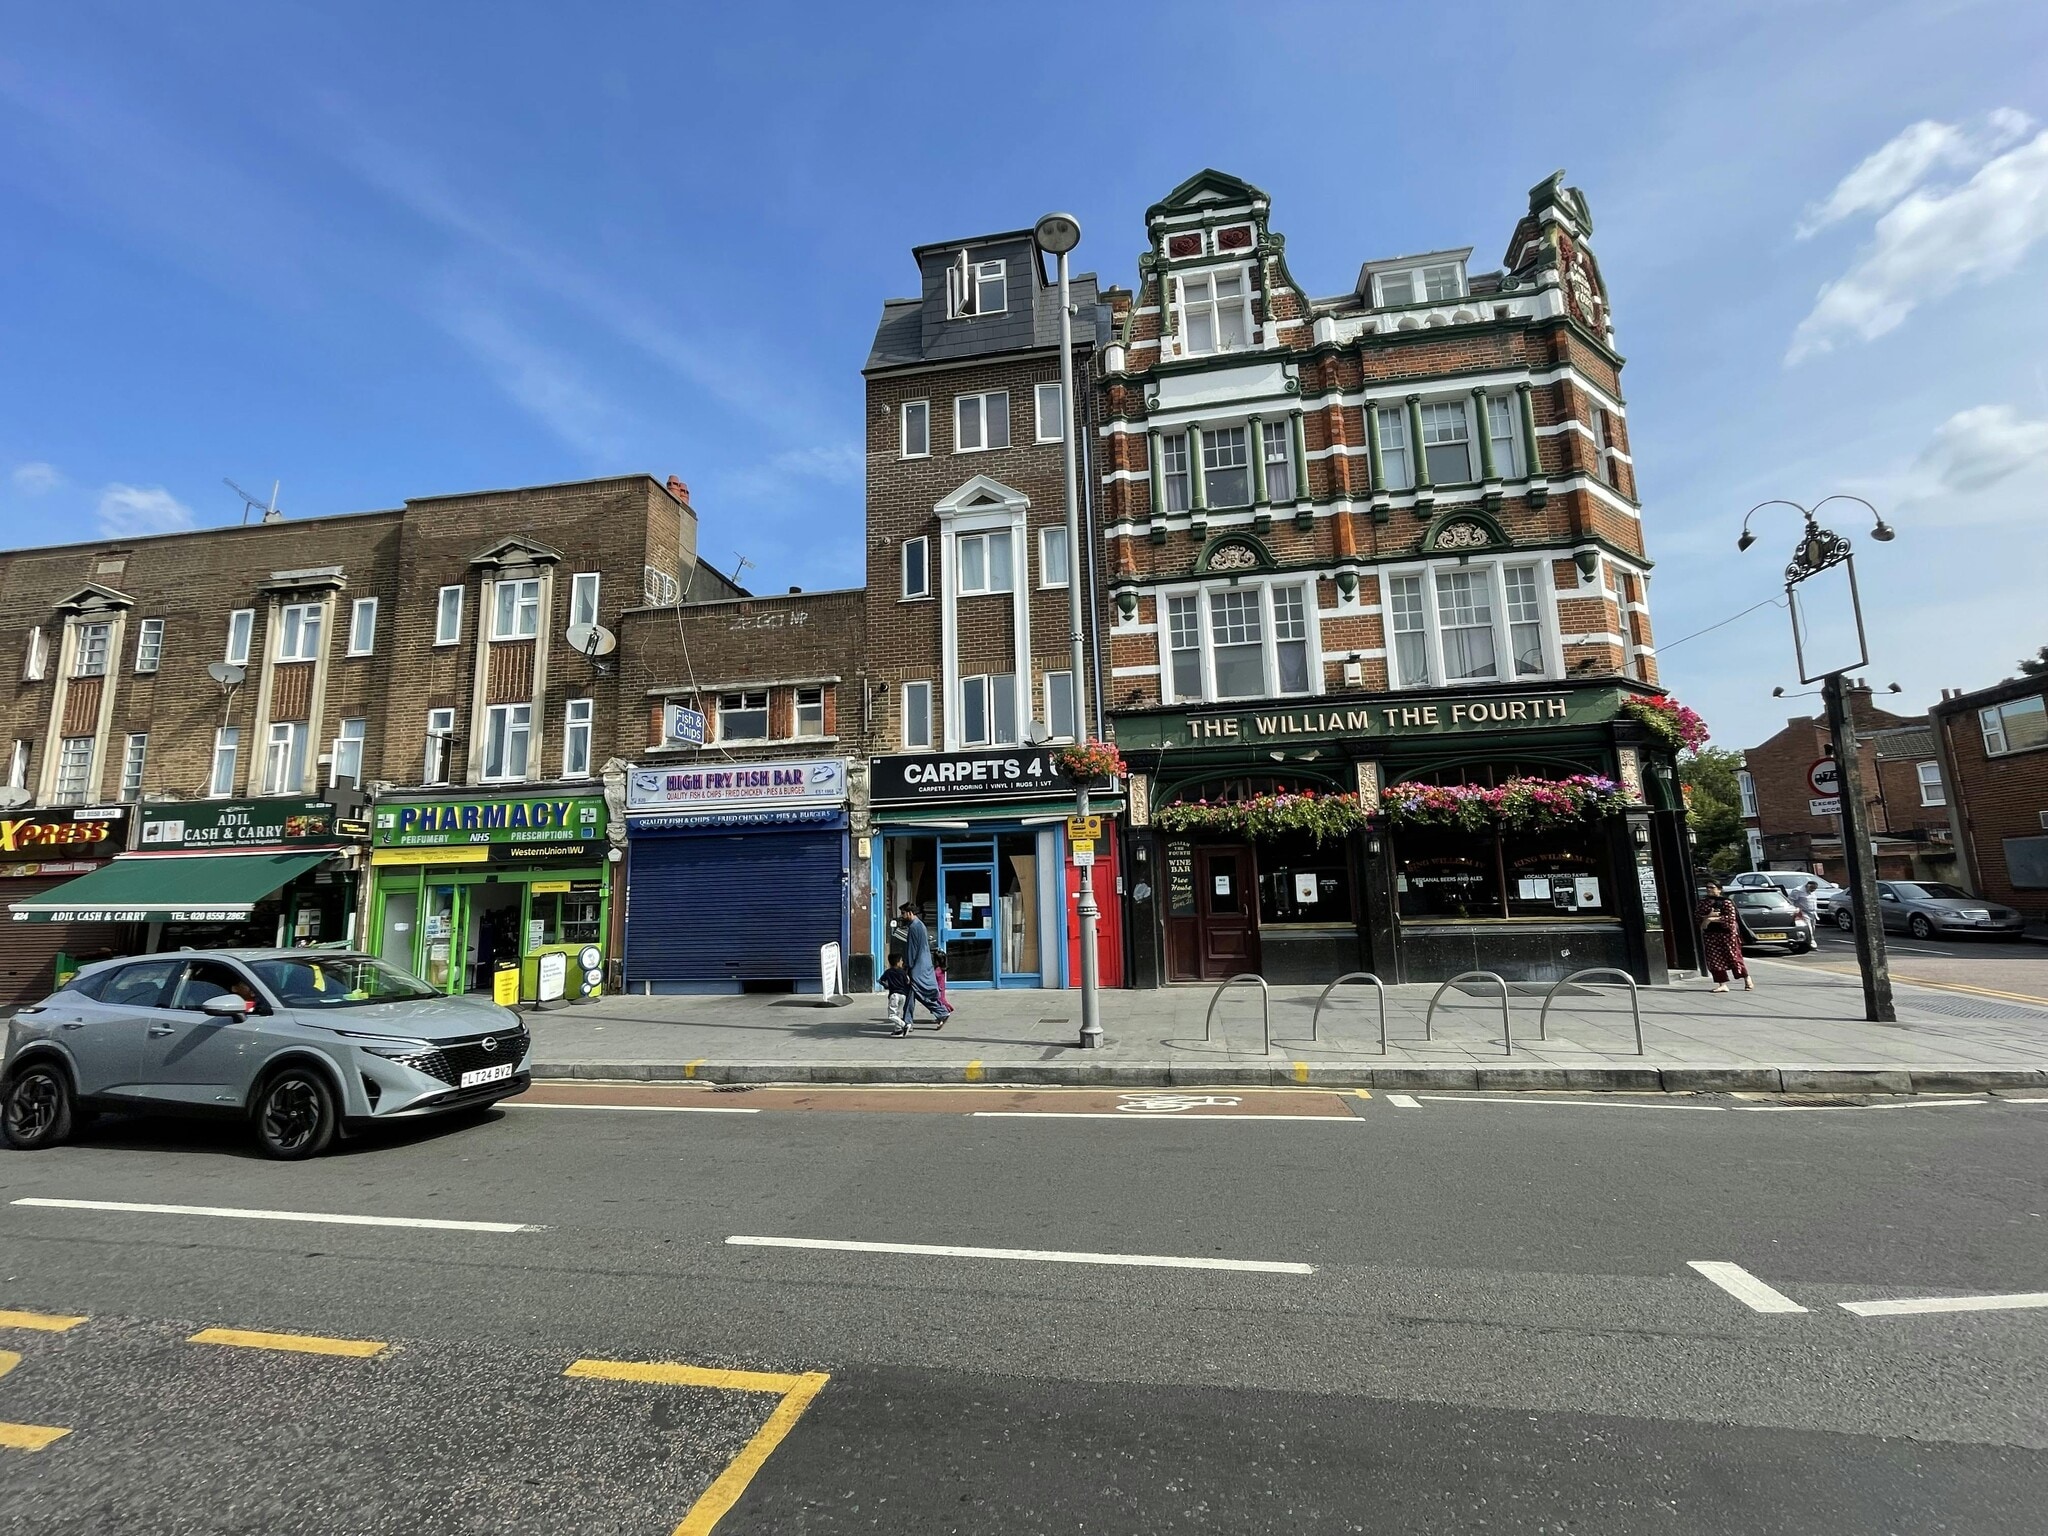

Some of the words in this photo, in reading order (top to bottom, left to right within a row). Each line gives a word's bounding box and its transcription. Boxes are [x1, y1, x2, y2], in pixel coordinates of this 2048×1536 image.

[676, 709, 694, 727] Fish
[696, 716, 702, 727] &
[1187, 717, 1239, 738] THE
[1255, 710, 1369, 735] WILLIAM
[1382, 706, 1439, 727] THE
[1451, 698, 1567, 724] FOURTH
[677, 722, 701, 739] Chips
[904, 758, 1021, 784] CARPETS
[1027, 757, 1042, 777] 4
[666, 774, 703, 791] HIGH
[706, 772, 734, 789] FRY
[736, 770, 770, 788] FISH
[774, 769, 803, 786] BAR
[667, 792, 688, 800] QUALITY
[707, 790, 722, 798] CHIPS
[725, 789, 740, 797] FRIED
[741, 788, 763, 796] CHICKEN
[784, 787, 806, 795] BURGER
[217, 814, 250, 826] ADIL
[401, 802, 574, 832] PHARMACY
[640, 818, 667, 826] QUALITY
[718, 814, 738, 822] FRIED
[738, 813, 769, 821] CHICKEN
[184, 827, 219, 841] CASH
[223, 828, 233, 839] &
[238, 825, 283, 839] CARRY
[401, 834, 449, 844] PERFUMERY
[469, 833, 490, 842] NHS
[511, 831, 574, 840] PRESCRIPTIONS
[511, 847, 568, 857] WesternUnion
[51, 912, 74, 921] ADIL
[77, 912, 103, 921] CASH
[104, 912, 111, 921] &
[114, 912, 147, 921] CARRY
[170, 912, 189, 921] TEL:
[190, 912, 205, 920] 020
[206, 912, 225, 920] 8558
[468, 1070, 492, 1084] LT24
